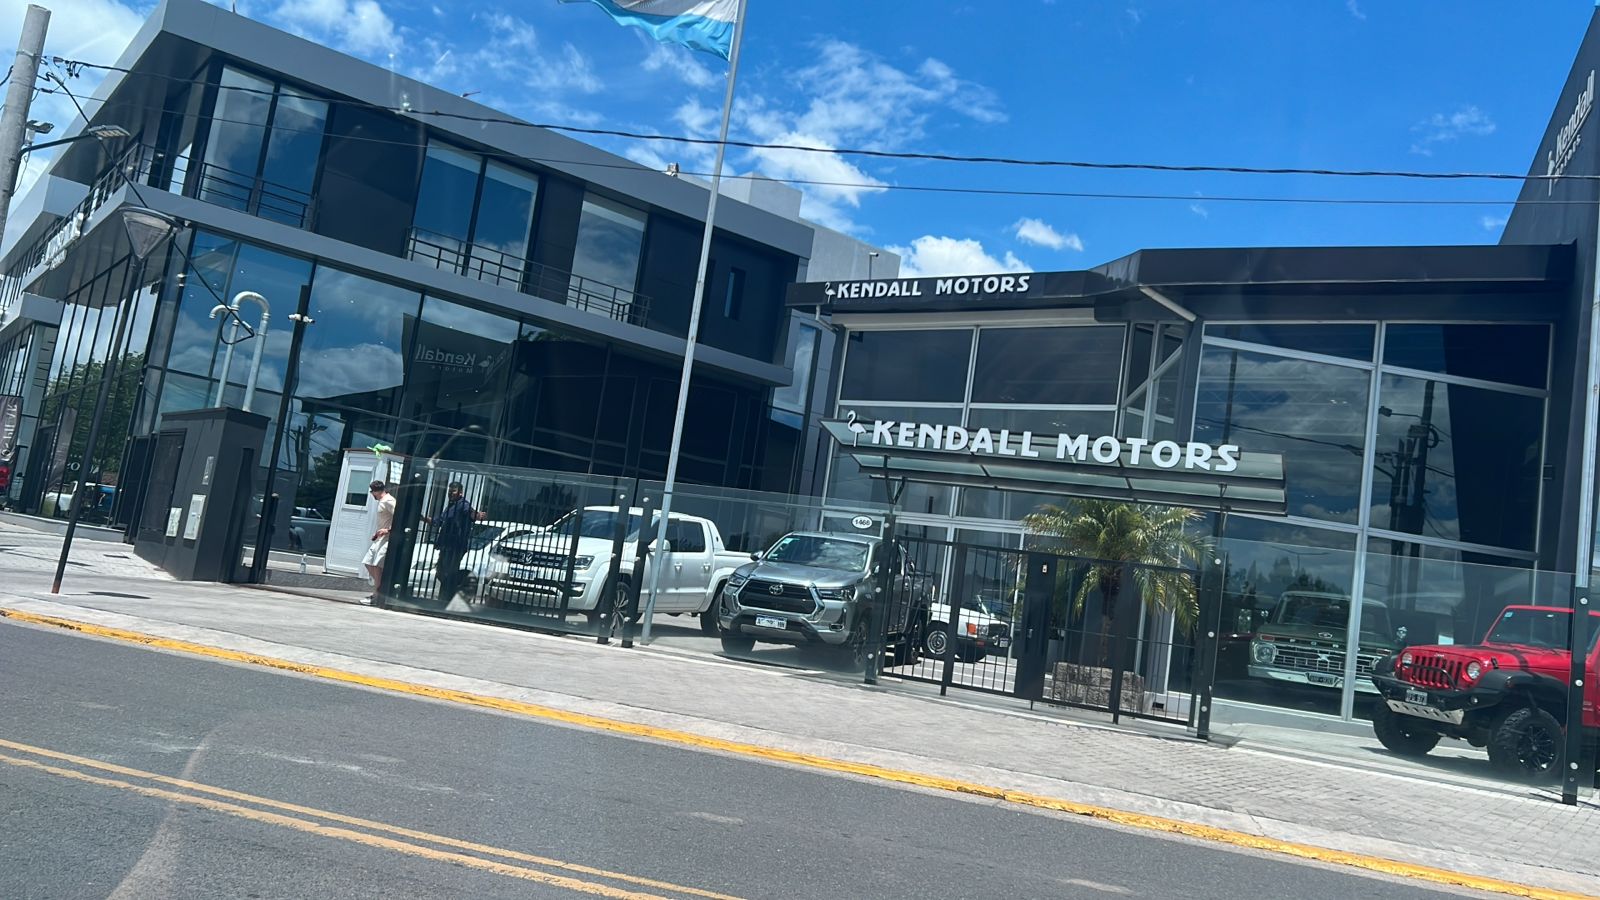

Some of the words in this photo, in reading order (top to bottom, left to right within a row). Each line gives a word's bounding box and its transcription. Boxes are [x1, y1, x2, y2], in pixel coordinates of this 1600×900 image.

[1555, 69, 1595, 163] Kendall
[837, 281, 922, 299] KENDALL
[935, 275, 1030, 294] MOTORS
[871, 420, 1039, 458] KENDALL
[1056, 433, 1240, 472] MOTORS
